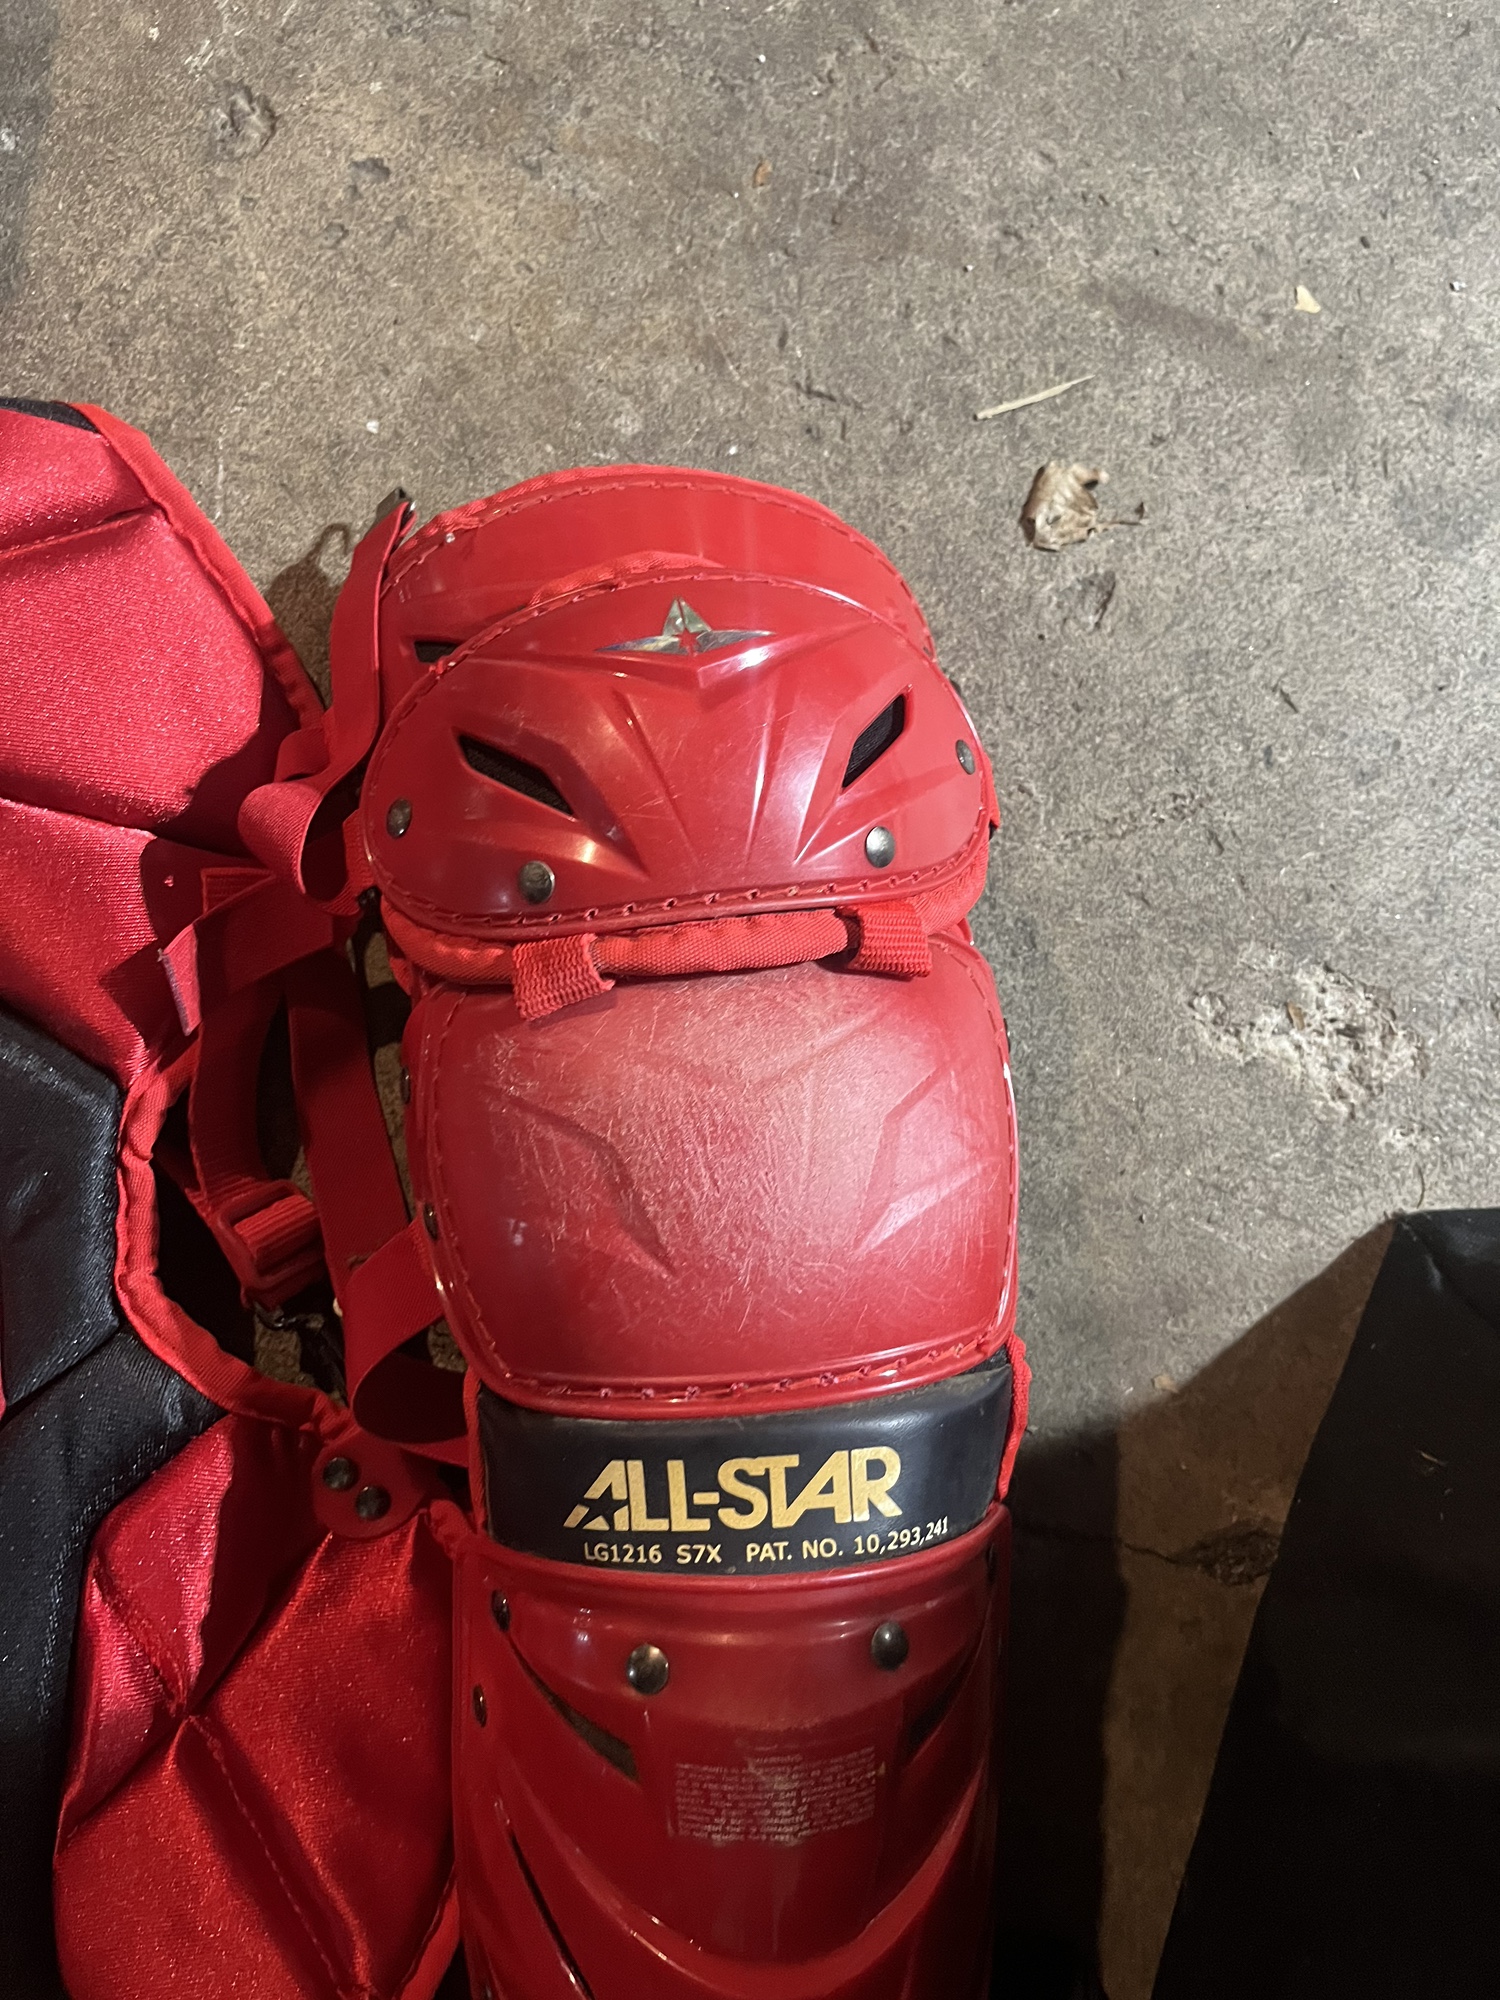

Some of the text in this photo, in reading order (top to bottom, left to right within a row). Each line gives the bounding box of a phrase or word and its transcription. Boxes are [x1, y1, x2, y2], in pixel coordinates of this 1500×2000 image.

[563, 1446, 903, 1532] ALL-STAR
[584, 1516, 949, 1564] LG1216 S7X PAT. NO. 10,293,241
